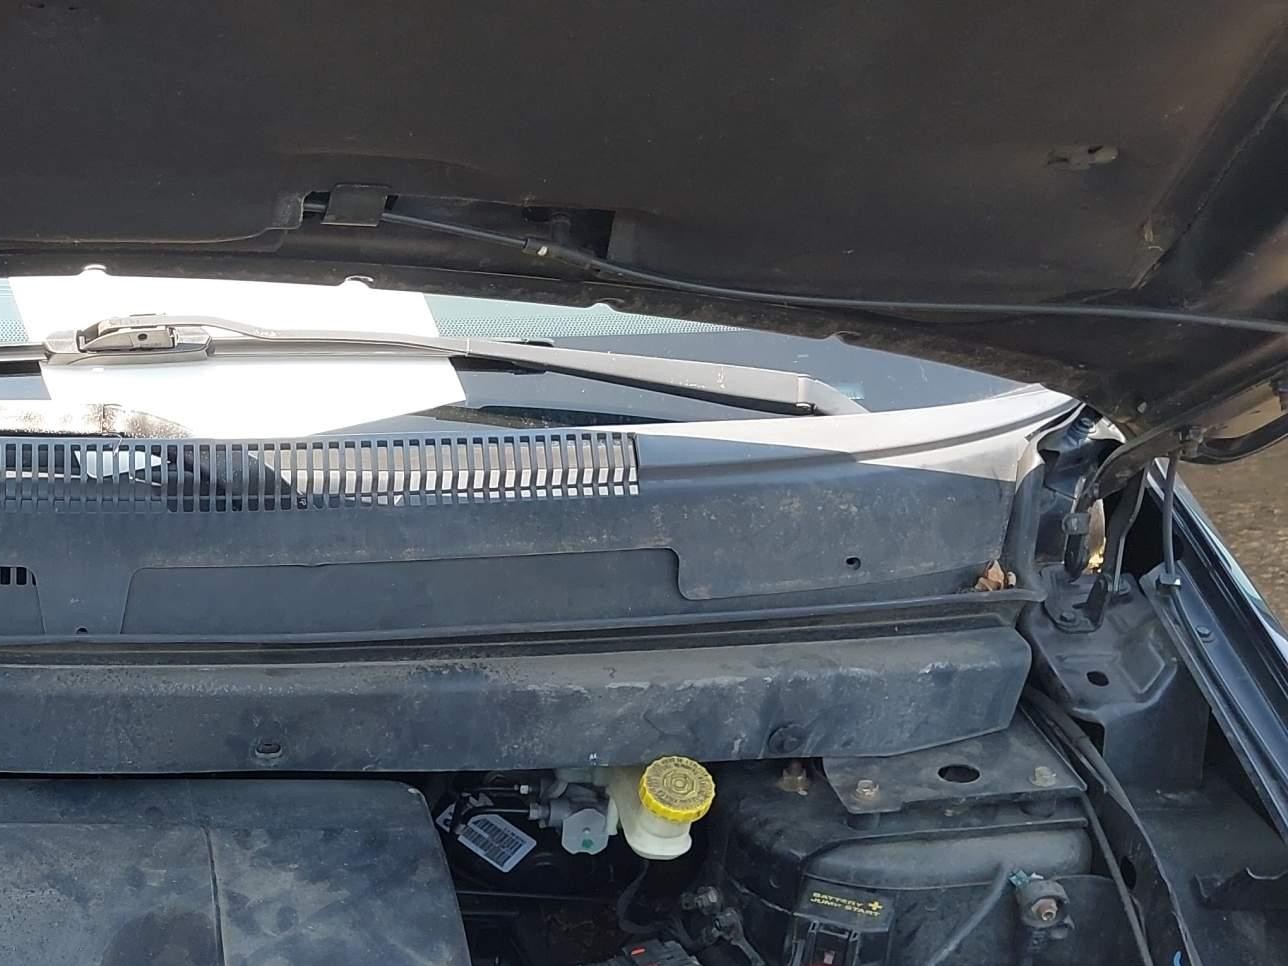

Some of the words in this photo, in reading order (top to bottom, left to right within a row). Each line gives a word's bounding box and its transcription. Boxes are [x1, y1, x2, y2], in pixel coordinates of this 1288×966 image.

[810, 898, 842, 908] JUMP
[845, 904, 881, 917] START
[812, 892, 863, 907] BATTERY
